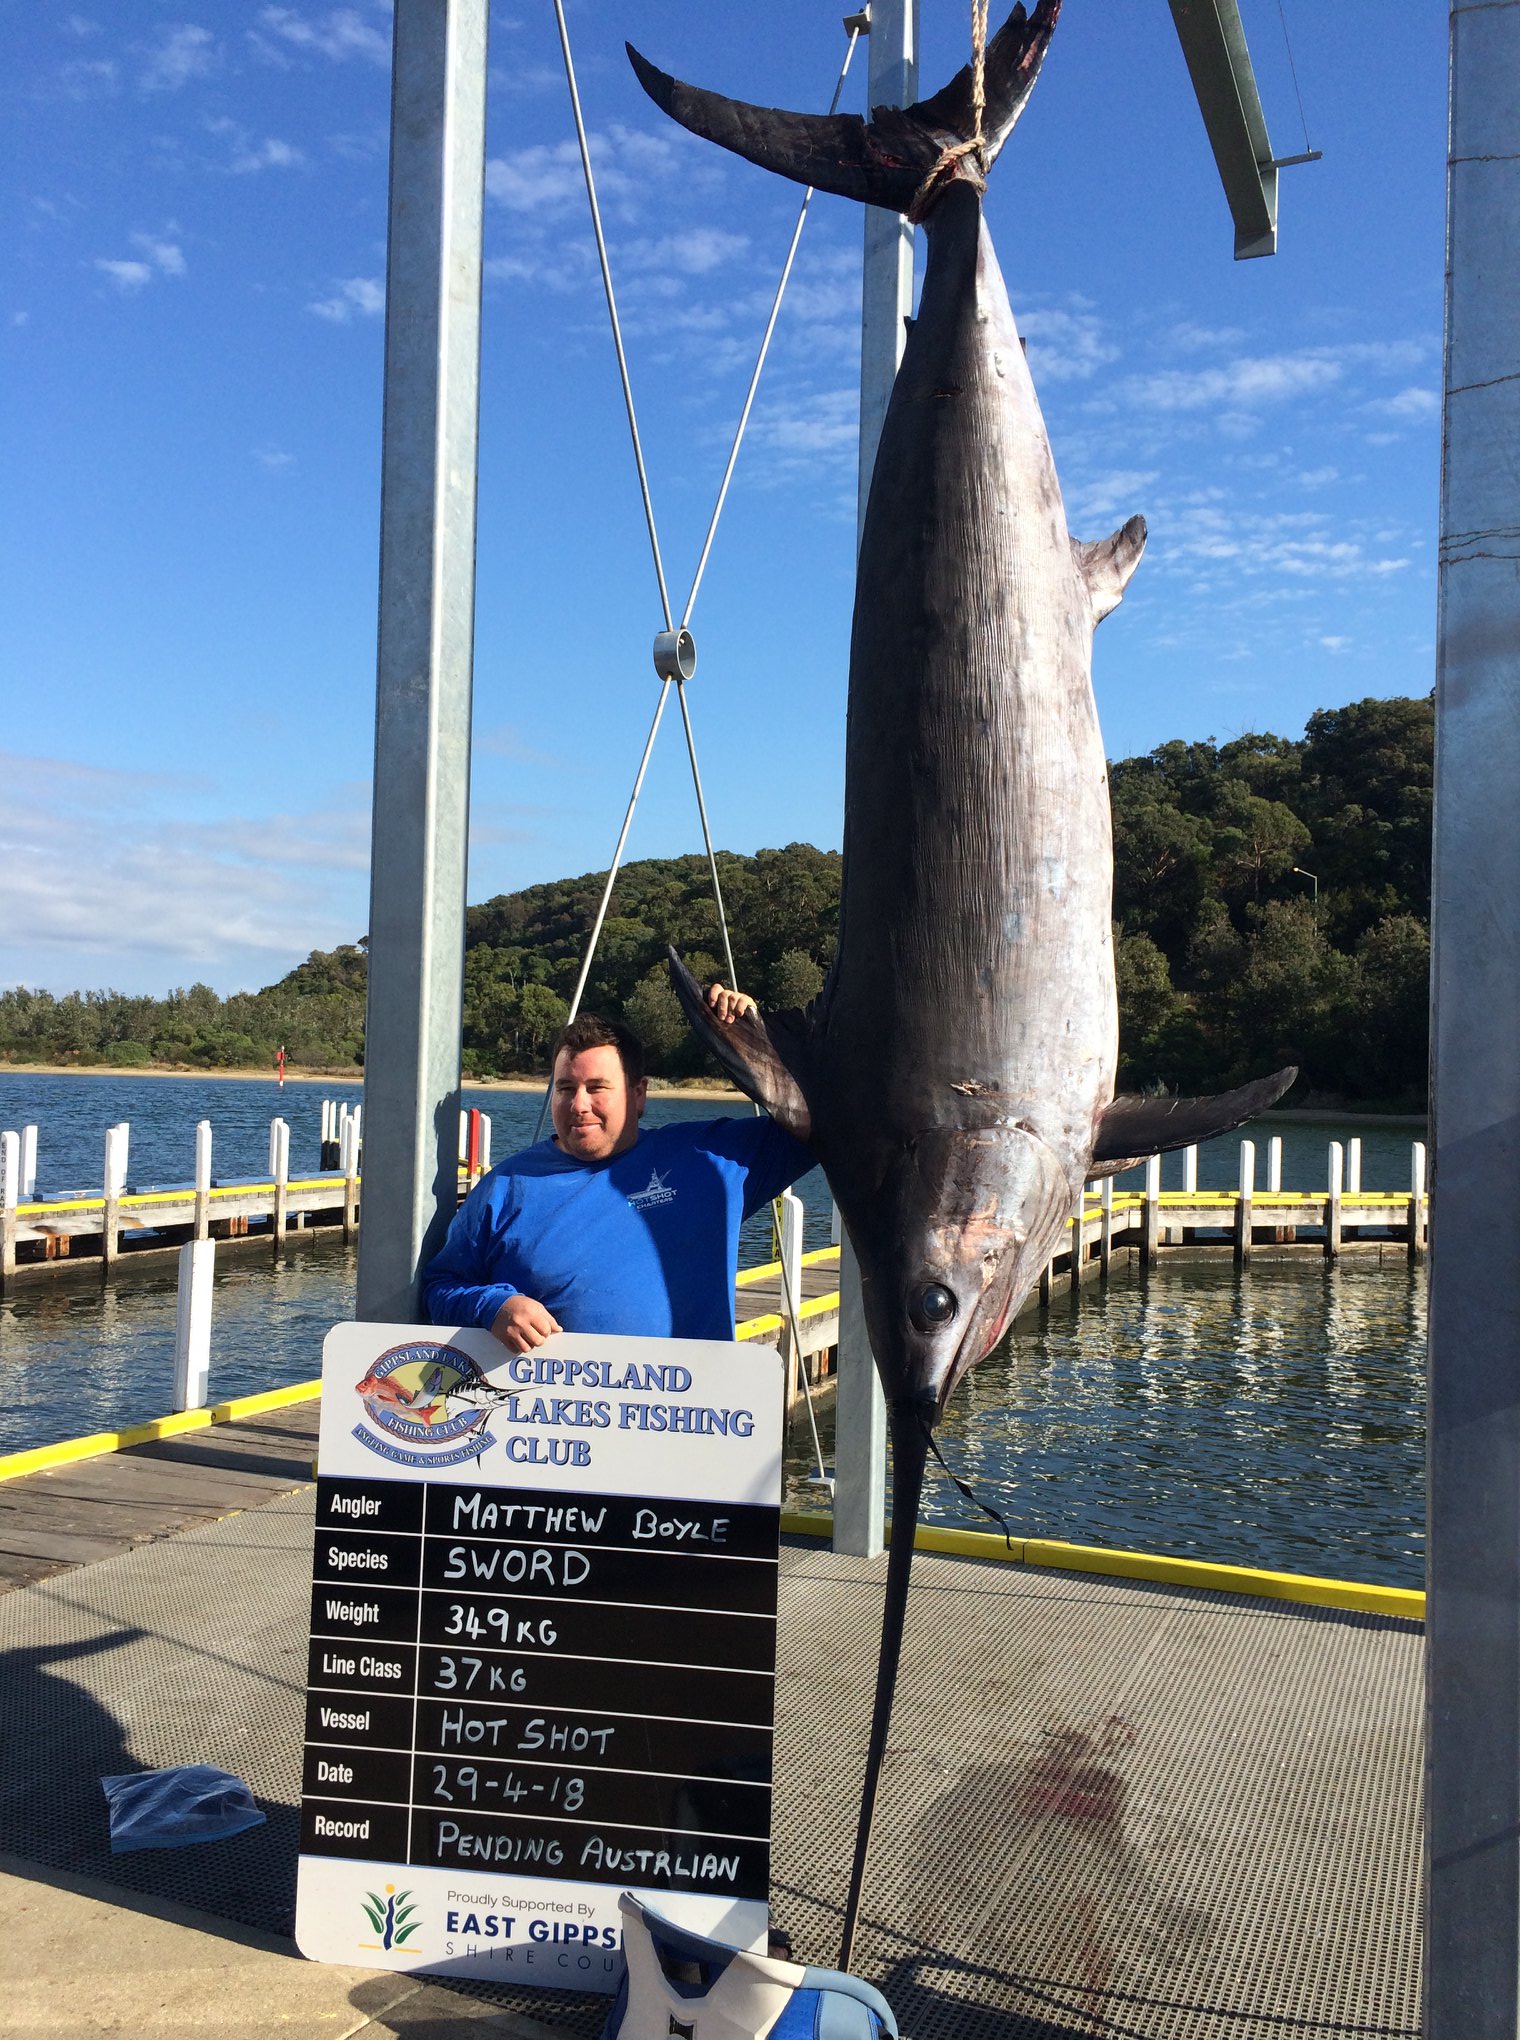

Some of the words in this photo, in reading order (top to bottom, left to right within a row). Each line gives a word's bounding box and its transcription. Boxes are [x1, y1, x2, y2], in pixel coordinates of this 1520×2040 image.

[636, 1197, 674, 1209] CHARTERS
[373, 1348, 440, 1379] GIPPSLAND
[508, 1357, 693, 1393] GIPPSLAND
[387, 1416, 434, 1438] FISHING
[436, 1416, 468, 1436] CLUB
[507, 1396, 611, 1428] LAKES
[618, 1402, 755, 1438] FISHING
[356, 1427, 390, 1455] ANGLING
[391, 1449, 416, 1464] GAME
[418, 1456, 426, 1465] &
[427, 1451, 460, 1465] SPORTS
[460, 1435, 493, 1458] FISHING
[505, 1435, 591, 1467] CLUB
[330, 1493, 382, 1518] Angler
[452, 1492, 609, 1533] MATTHEW
[328, 1546, 389, 1571] Species
[443, 1545, 591, 1588] SWORD
[325, 1600, 380, 1625] Weight
[322, 1653, 357, 1675] Line
[359, 1656, 402, 1681] Class
[320, 1706, 370, 1731] Vessel
[440, 1706, 508, 1747] HOT
[517, 1718, 616, 1756] SHOT
[317, 1761, 354, 1785] Date
[432, 1764, 587, 1812] 29-4-18
[314, 1815, 370, 1841] Record
[436, 1821, 565, 1867] PENDING
[579, 1835, 741, 1882] AUSTRLIAN
[446, 1890, 499, 1909] Proudly
[501, 1895, 574, 1914] Supported
[577, 1903, 596, 1918] By
[446, 1911, 514, 1938] EAST
[528, 1920, 624, 1951] GIPPS
[445, 1943, 536, 1965] SHIRE
